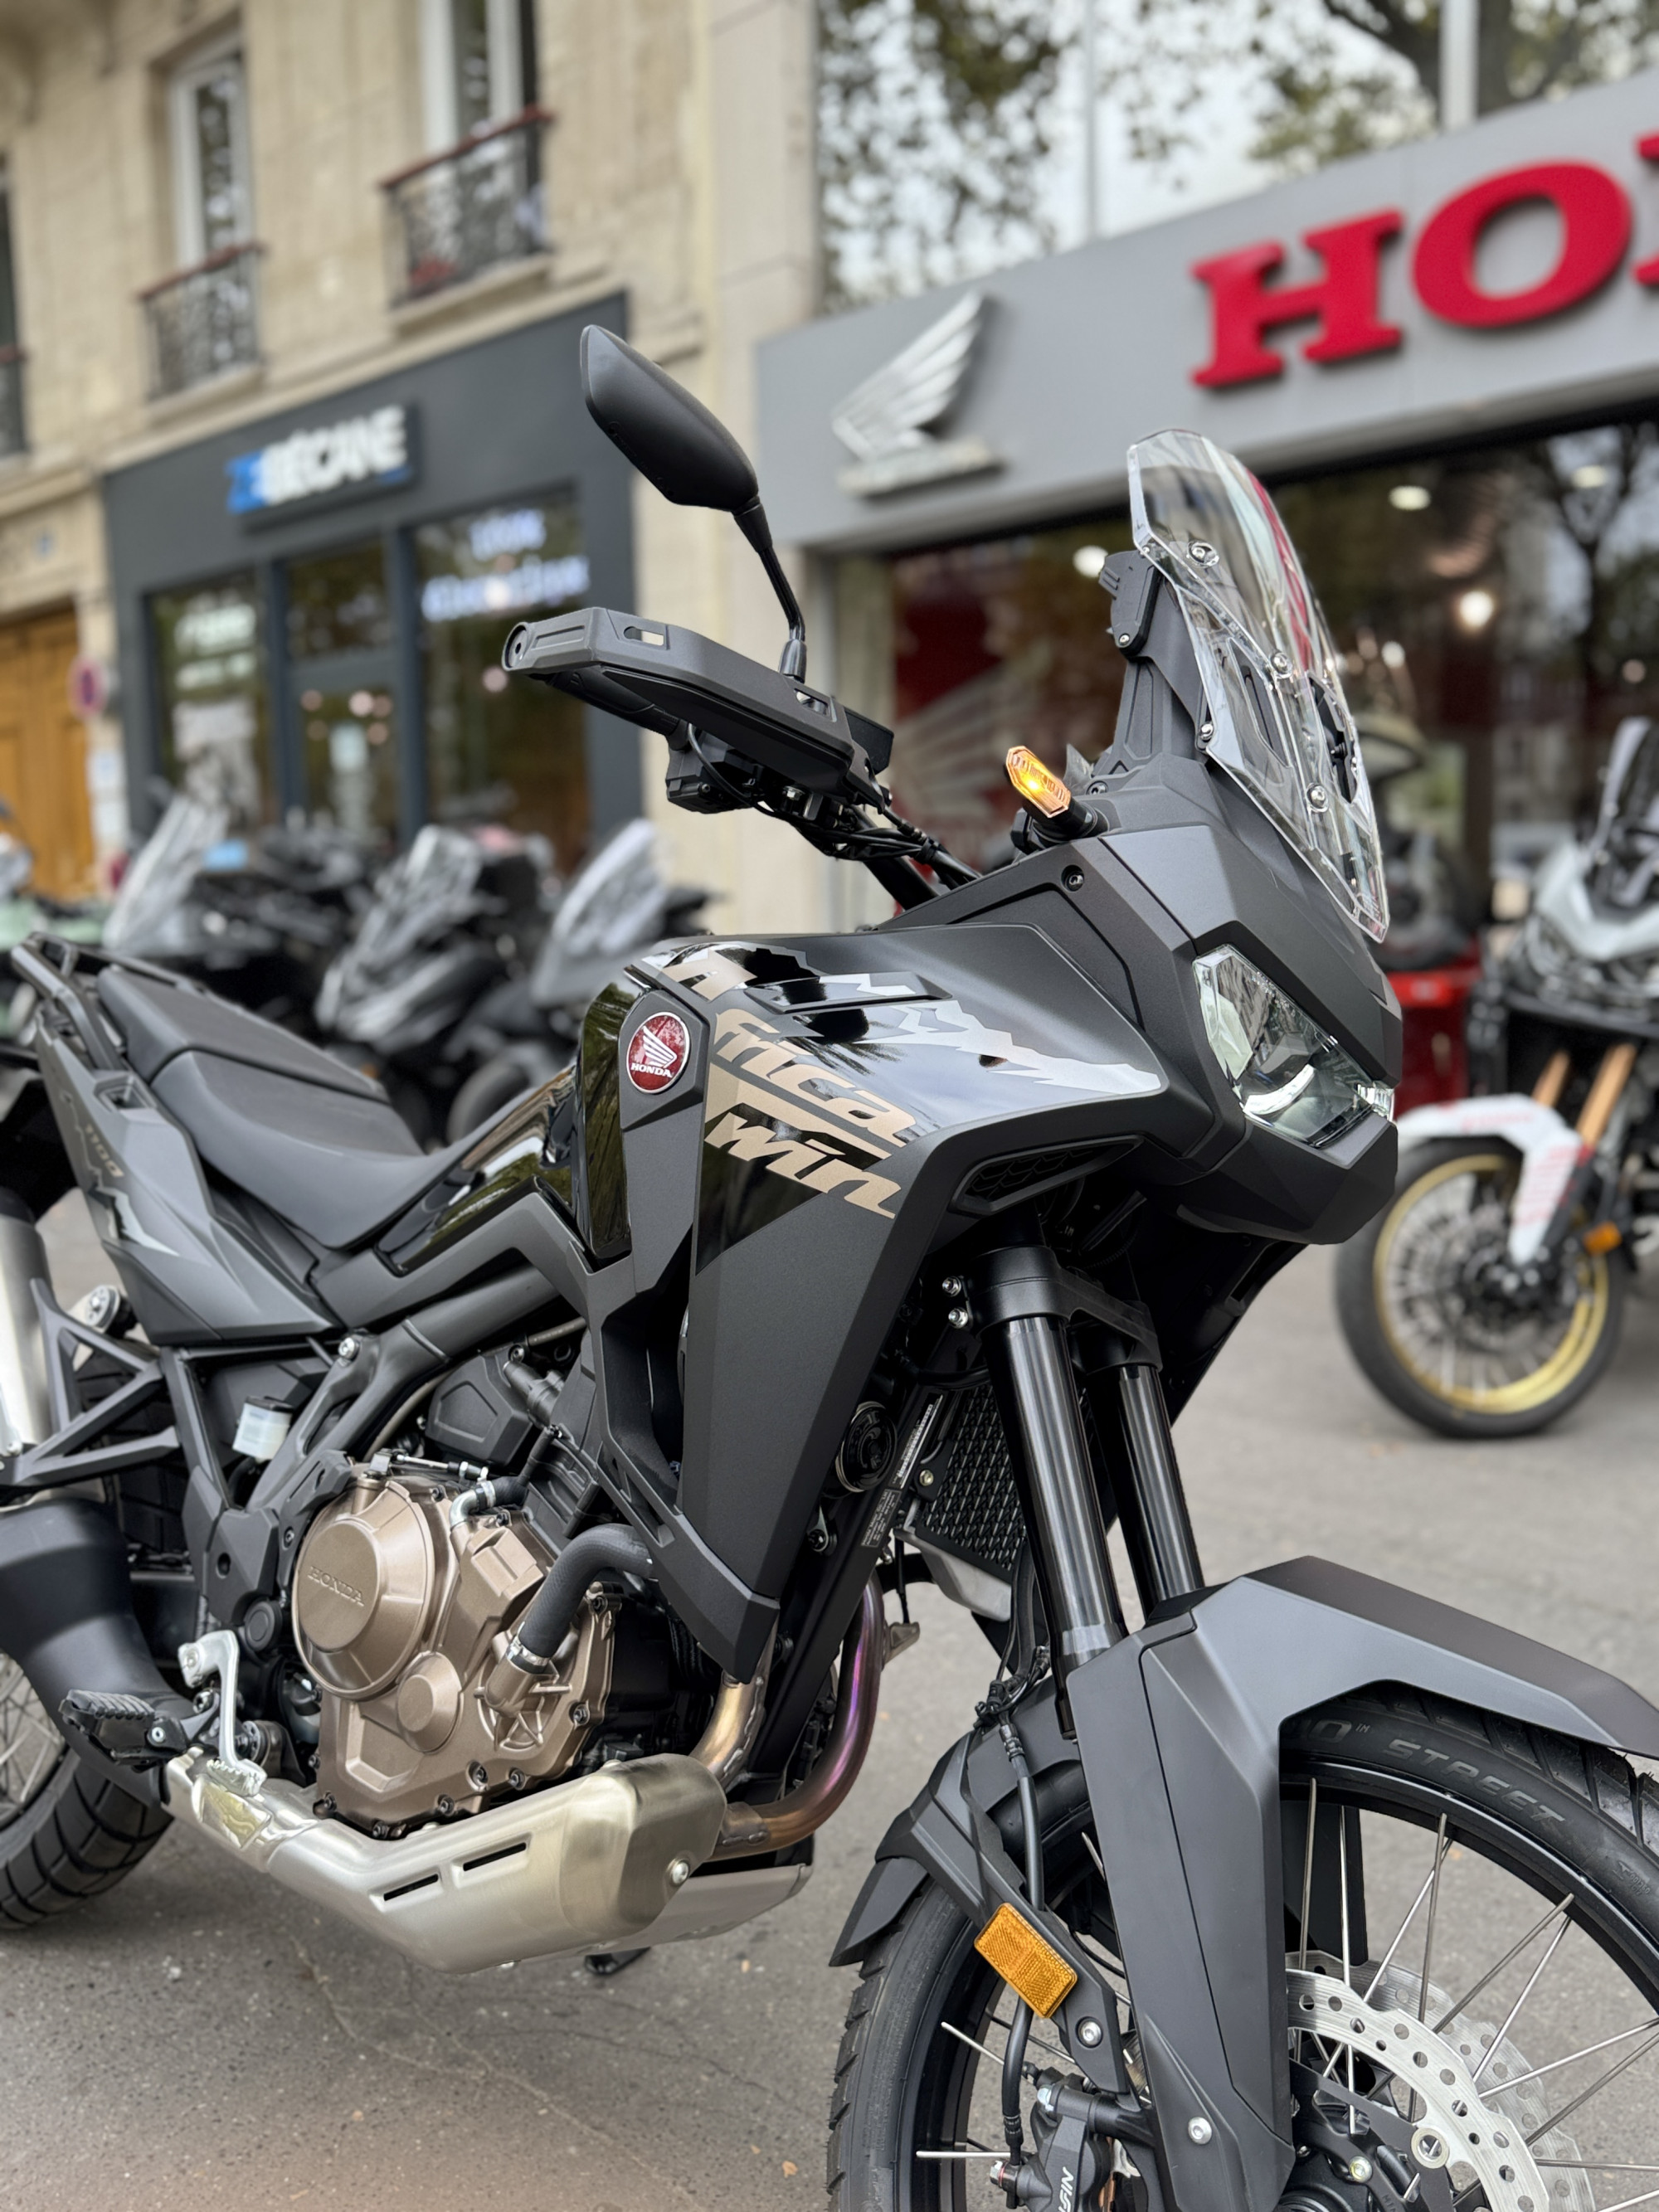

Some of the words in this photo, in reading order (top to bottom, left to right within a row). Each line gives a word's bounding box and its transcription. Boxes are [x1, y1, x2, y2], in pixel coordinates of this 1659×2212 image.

[1191, 129, 1659, 386] HO
[630, 1062, 673, 1078] HONDA
[307, 1566, 365, 1605] HONDA
[1383, 1738, 1565, 1822] STREET
